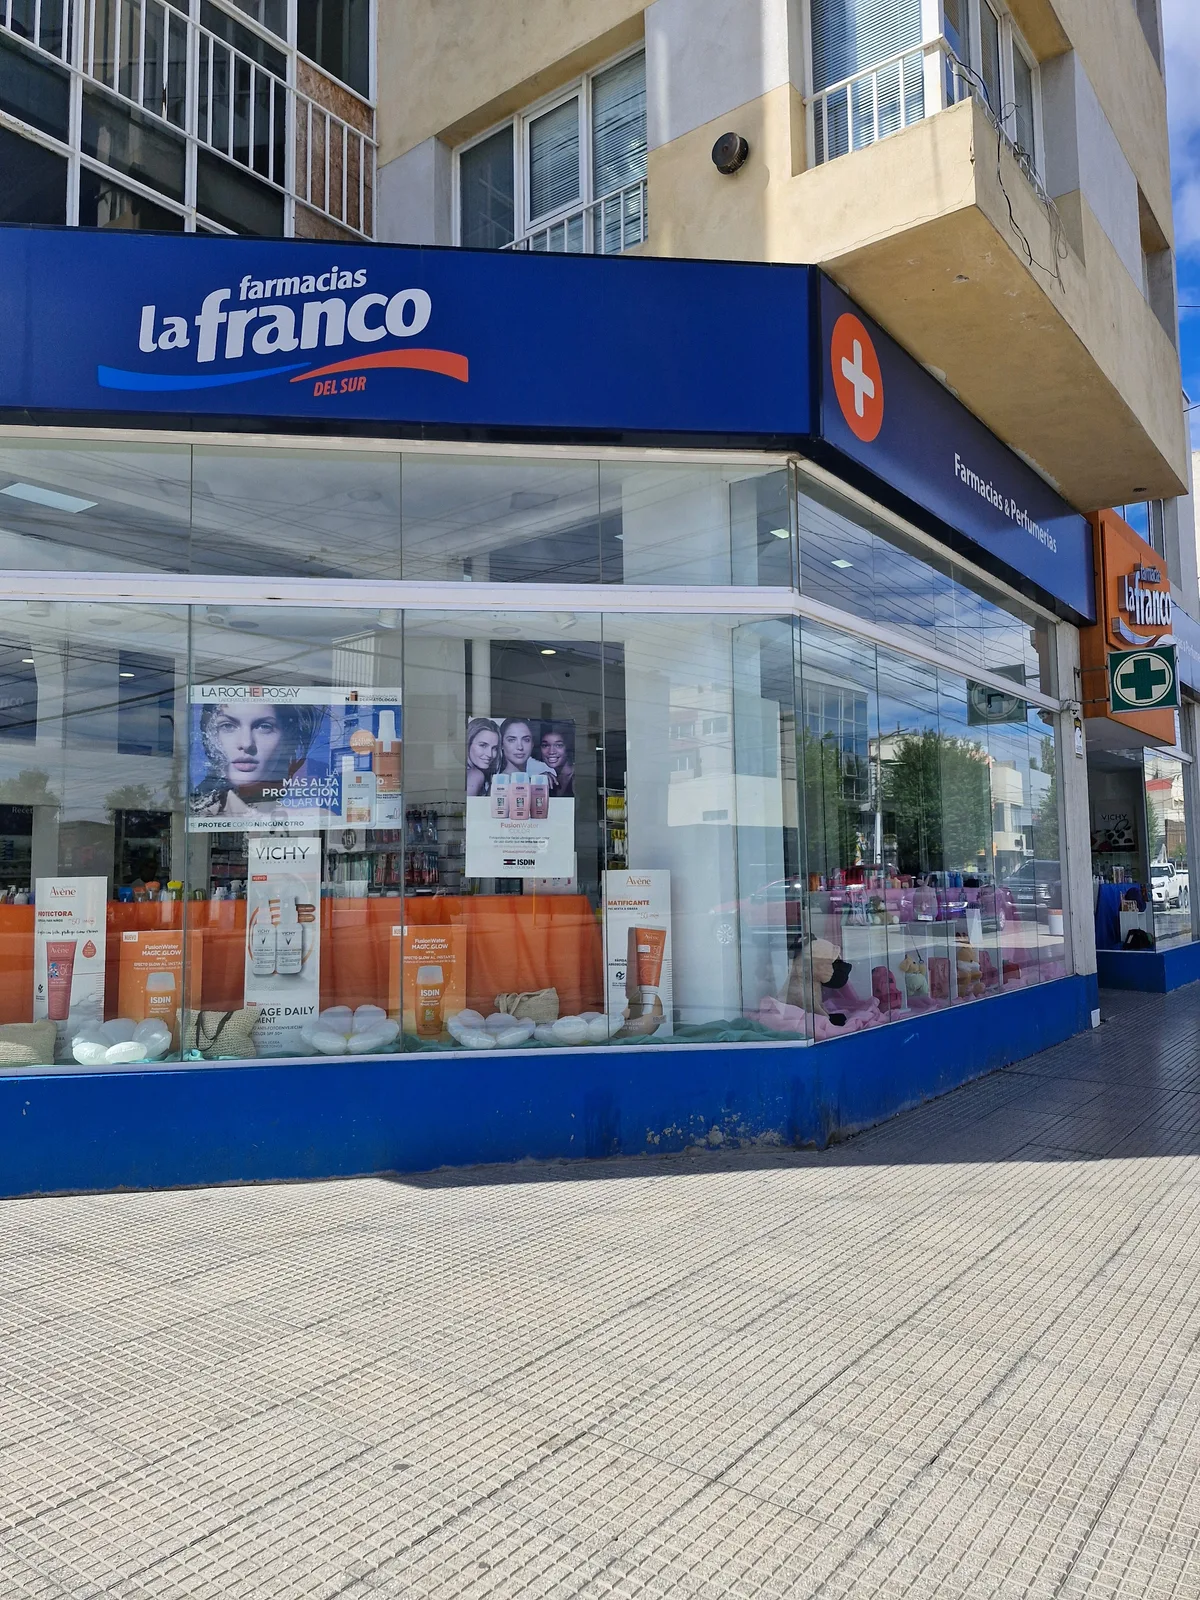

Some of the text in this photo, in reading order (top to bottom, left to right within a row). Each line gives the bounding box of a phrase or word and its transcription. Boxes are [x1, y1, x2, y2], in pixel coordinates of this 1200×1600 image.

[239, 265, 368, 301] farmacias
[138, 288, 433, 363] la franco
[313, 376, 367, 397] DEL SUR
[954, 452, 1057, 553] Farmacias & Perfumerías
[1124, 570, 1172, 626] la franco
[201, 687, 217, 697] LA
[326, 768, 339, 777] LA
[283, 777, 308, 787] MÁS
[310, 778, 339, 787] ALTA
[262, 786, 339, 797] PROTECCIÓN
[275, 798, 313, 808] SOLAR
[315, 798, 339, 807] UVA
[1101, 813, 1127, 821] VICHY
[256, 847, 310, 860] VICHY
[626, 876, 652, 885] Avène
[50, 886, 77, 896] Avène
[150, 996, 171, 1004] ISDIN
[260, 1006, 315, 1016] AGE DAILY
